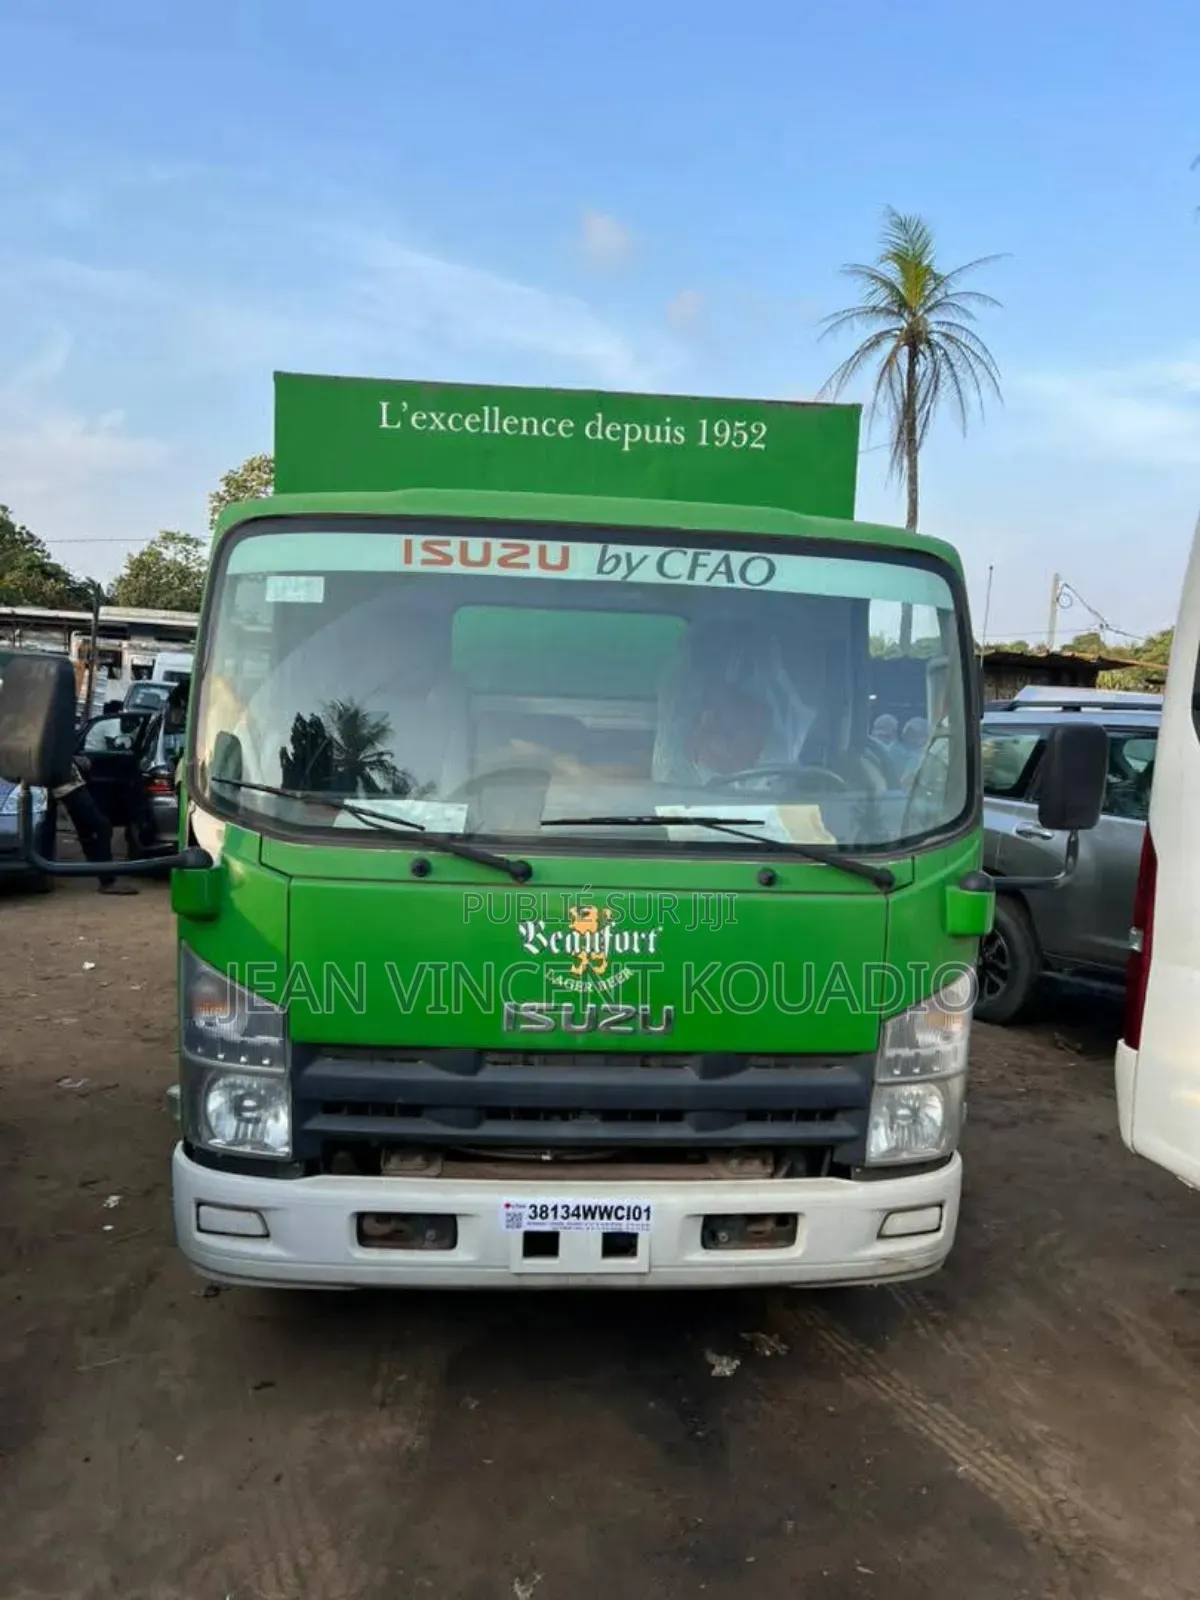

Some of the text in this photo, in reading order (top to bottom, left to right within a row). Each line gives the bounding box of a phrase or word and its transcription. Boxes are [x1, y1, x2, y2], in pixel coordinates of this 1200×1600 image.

[585, 413, 686, 451] depuis
[698, 418, 768, 450] 1952
[403, 538, 777, 587] ISUZU by CFAO
[518, 920, 660, 957] Beaufort
[544, 966, 634, 993] LAGER BEER
[503, 1001, 676, 1035] ISUZU
[528, 1203, 651, 1221] 38134WWCI01
